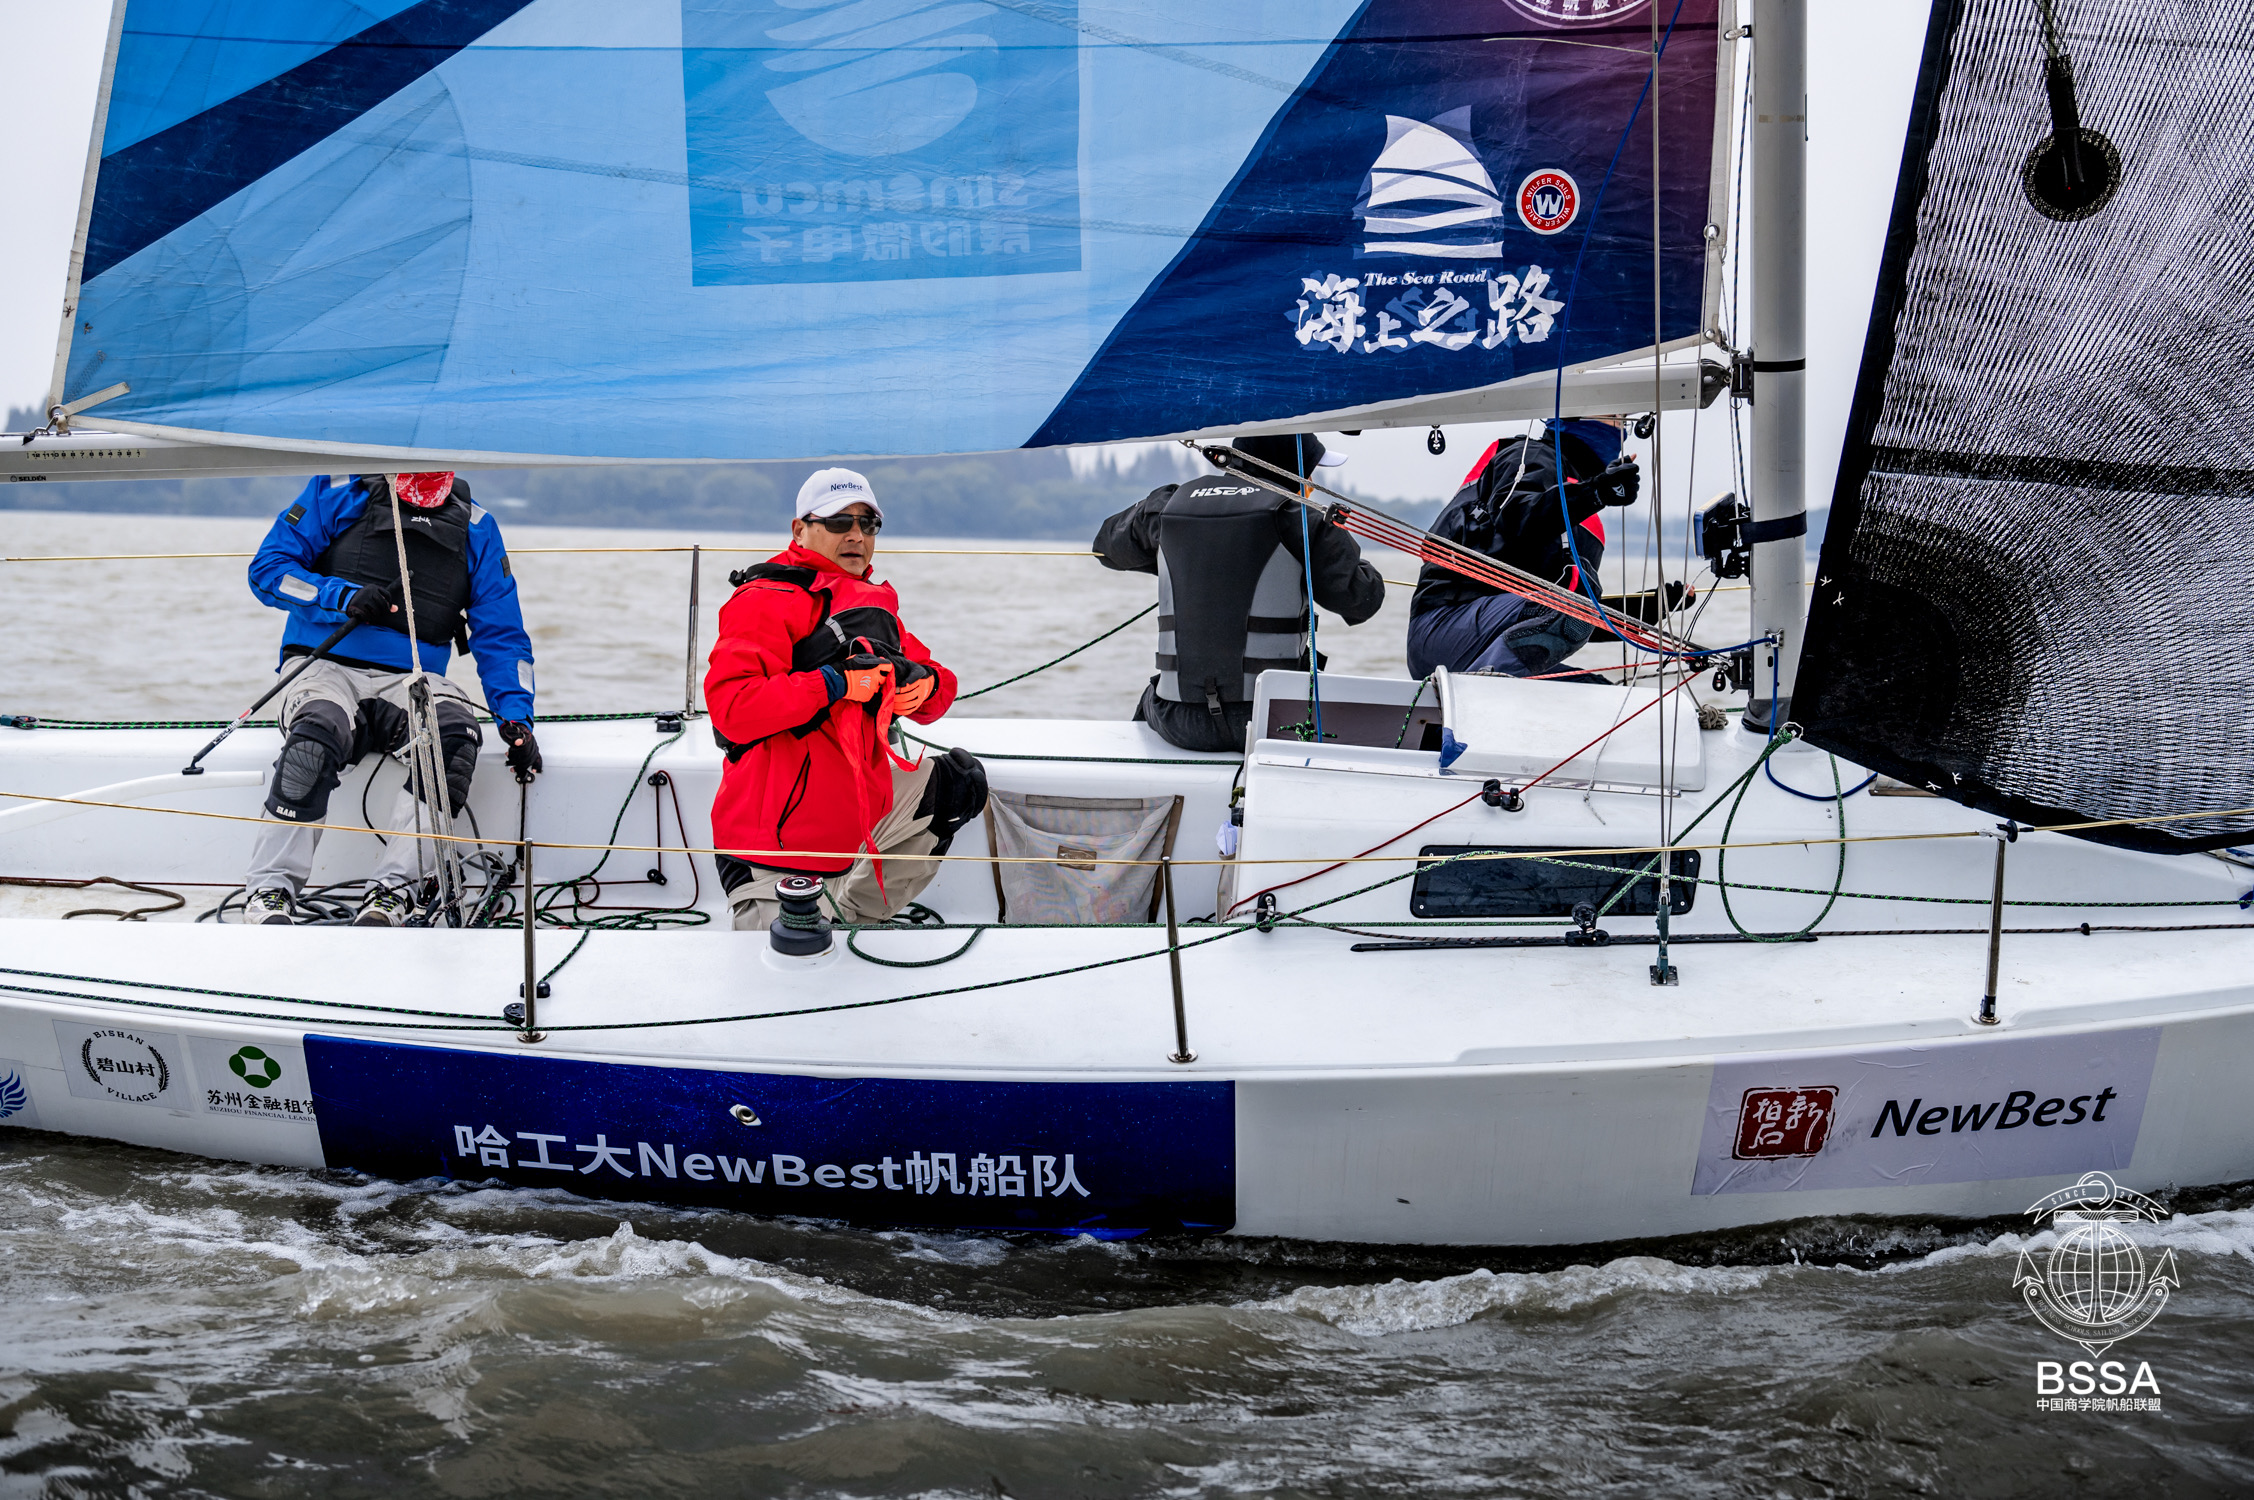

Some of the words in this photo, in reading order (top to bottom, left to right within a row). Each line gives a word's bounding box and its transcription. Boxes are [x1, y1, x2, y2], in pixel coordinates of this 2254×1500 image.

[1525, 177, 1552, 198] WILFER
[1554, 179, 1571, 200] SAILS
[1525, 204, 1543, 225] SAILS
[1545, 207, 1571, 227] WILFER
[1364, 272, 1399, 287] The
[1401, 271, 1434, 285] Sea
[1439, 269, 1488, 285] Road
[1295, 264, 1566, 354] 海上之路
[830, 481, 863, 492] NewBest
[93, 1030, 145, 1045] BISHAN
[96, 1057, 156, 1078] 碧山村
[107, 1086, 158, 1102] VILLAGE
[209, 1105, 242, 1115] SUZHOU
[244, 1110, 287, 1119] FINANCIAL
[288, 1114, 316, 1122] LEASIN
[1869, 1085, 2117, 1139] NewBest
